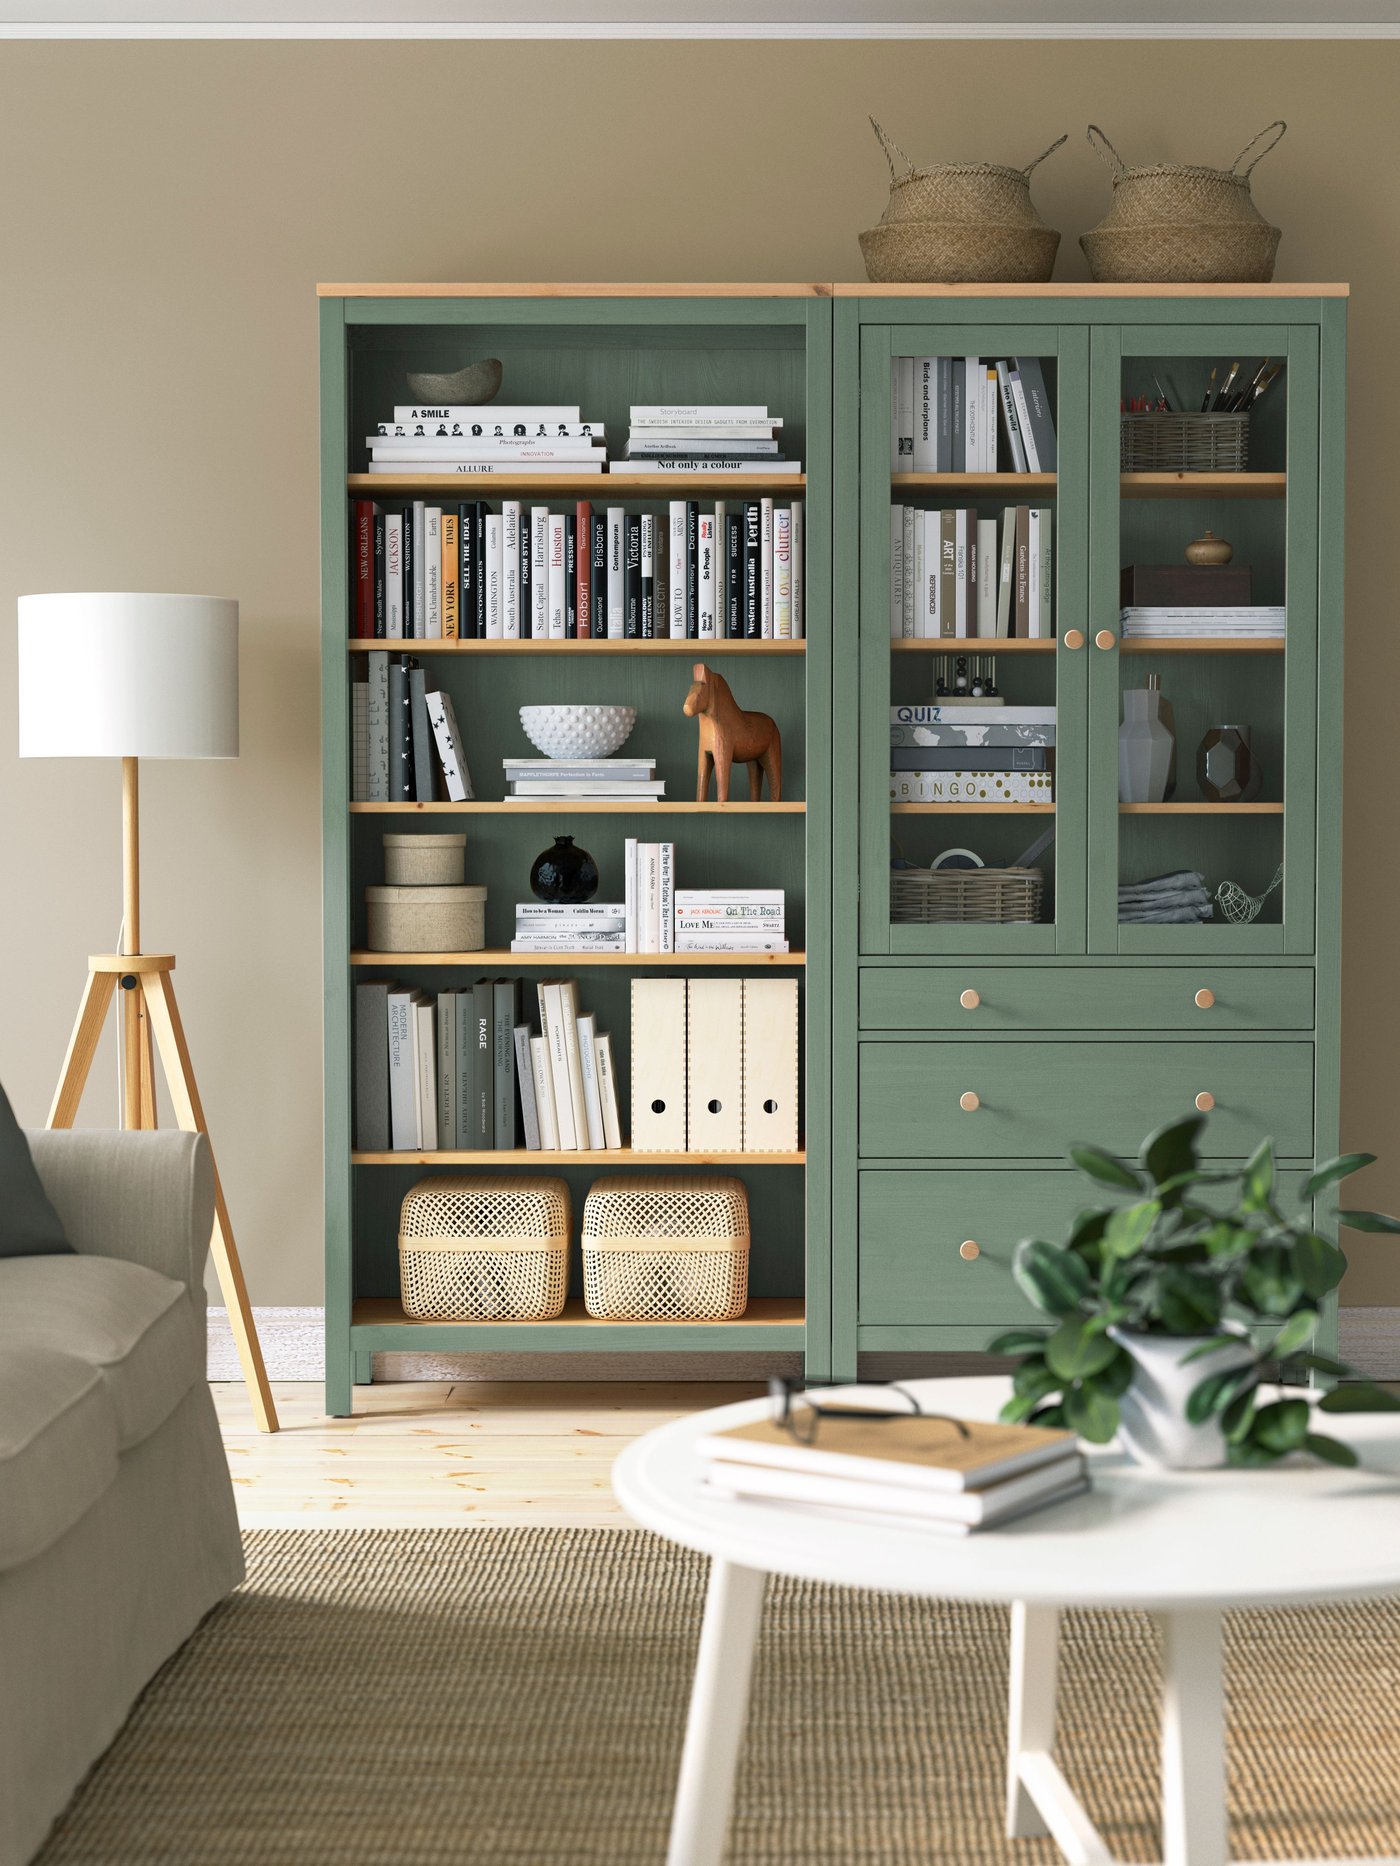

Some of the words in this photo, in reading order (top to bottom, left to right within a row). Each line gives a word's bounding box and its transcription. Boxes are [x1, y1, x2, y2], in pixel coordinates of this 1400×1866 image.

[411, 410, 418, 418] A
[421, 410, 450, 418] SMILE
[660, 408, 697, 416] Storyboard
[1006, 401, 1014, 414] the
[1031, 389, 1043, 418] interiors
[921, 403, 930, 441] airplanes
[1008, 414, 1017, 432] wild
[658, 461, 676, 469] Not
[678, 461, 699, 471] only
[711, 461, 742, 469] colour
[360, 517, 368, 558] ORLEANS
[429, 518, 437, 536] Earth
[506, 509, 516, 550] Adelaide
[534, 516, 546, 567] Harrisburg
[747, 507, 758, 547] Perth
[775, 514, 789, 562] clutter
[389, 529, 398, 575] JACKSON
[552, 527, 562, 567] Houston
[594, 524, 604, 567] Brisbane
[627, 526, 639, 570] Victoria
[647, 550, 651, 558] OF
[703, 548, 711, 569] People
[943, 540, 954, 561] ART
[704, 571, 710, 580] So
[747, 558, 755, 598] Australia
[779, 566, 790, 596] over
[893, 538, 902, 605] ANTIQUAIRES
[429, 565, 437, 609] Uninhabitable
[446, 581, 454, 610] YORK
[490, 571, 498, 625] WASHINGTON
[507, 570, 515, 605] Australia
[536, 583, 546, 610] Capital
[657, 580, 665, 600] CITY
[674, 588, 682, 601] TO
[429, 610, 437, 624] The
[579, 582, 588, 627] Hobart
[628, 598, 636, 634] Melbourne
[657, 603, 665, 628] MILES
[674, 604, 682, 626] HOW
[775, 601, 790, 635] mind
[446, 611, 454, 636] NEW
[536, 611, 544, 631] State
[610, 607, 623, 633] Italia
[647, 628, 652, 637] OF
[897, 707, 942, 722] QUIZ
[901, 782, 976, 795] BINGO
[662, 866, 670, 876] Over
[726, 907, 738, 916] On
[741, 907, 757, 916] The
[760, 907, 781, 916] Road
[391, 1004, 400, 1067] ARCHITECTURE
[399, 1004, 407, 1040] MODERN
[479, 1018, 487, 1049] RAGE
[583, 1035, 592, 1079] PHOTOGRAPHY
